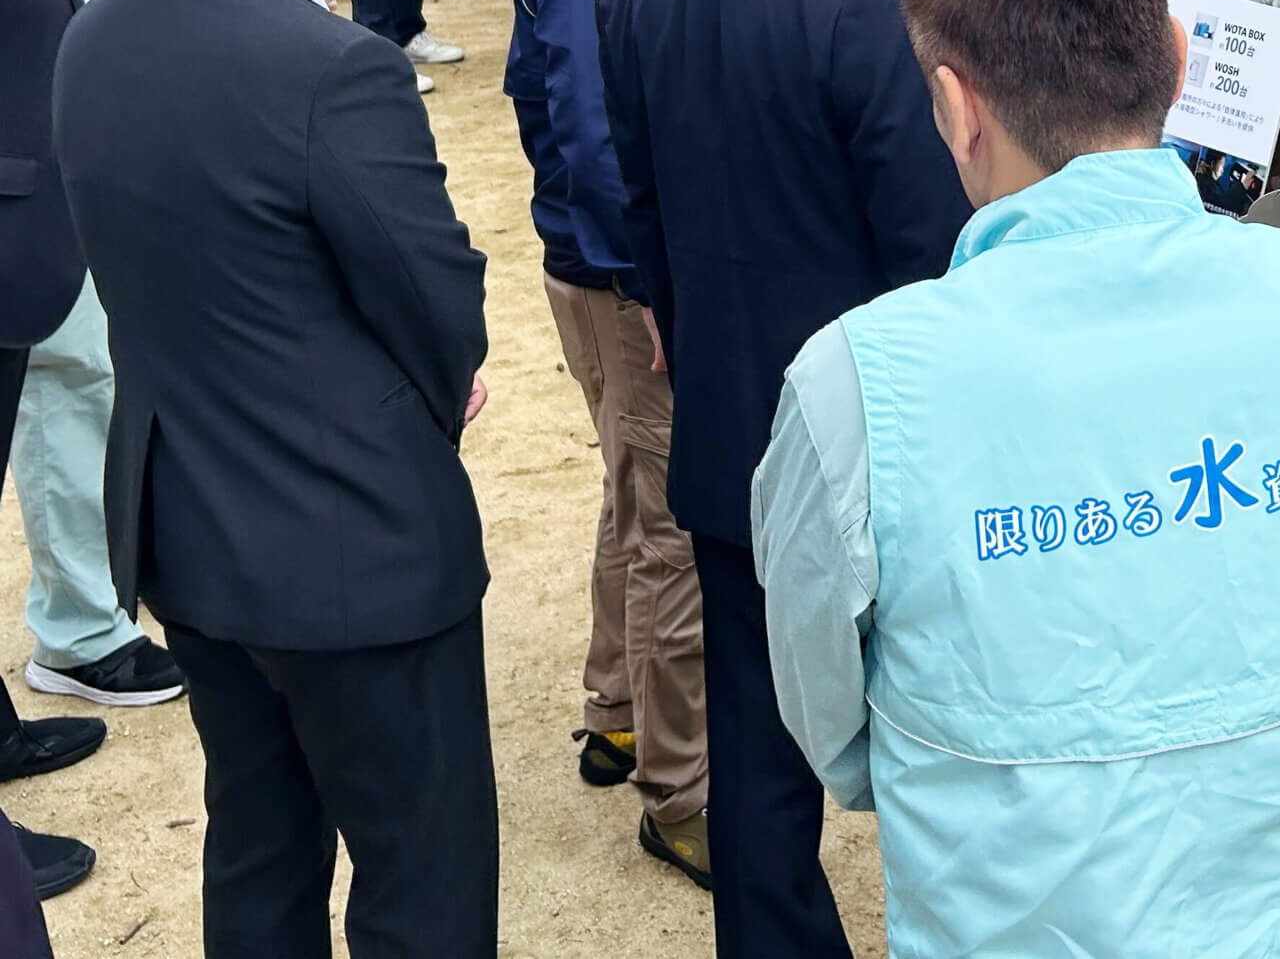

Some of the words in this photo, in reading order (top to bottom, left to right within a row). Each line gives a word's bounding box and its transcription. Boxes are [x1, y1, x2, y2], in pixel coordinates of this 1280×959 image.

[1225, 24, 1246, 36] WOTA
[1248, 29, 1265, 41] BOX
[1215, 62, 1240, 76] WOSH
